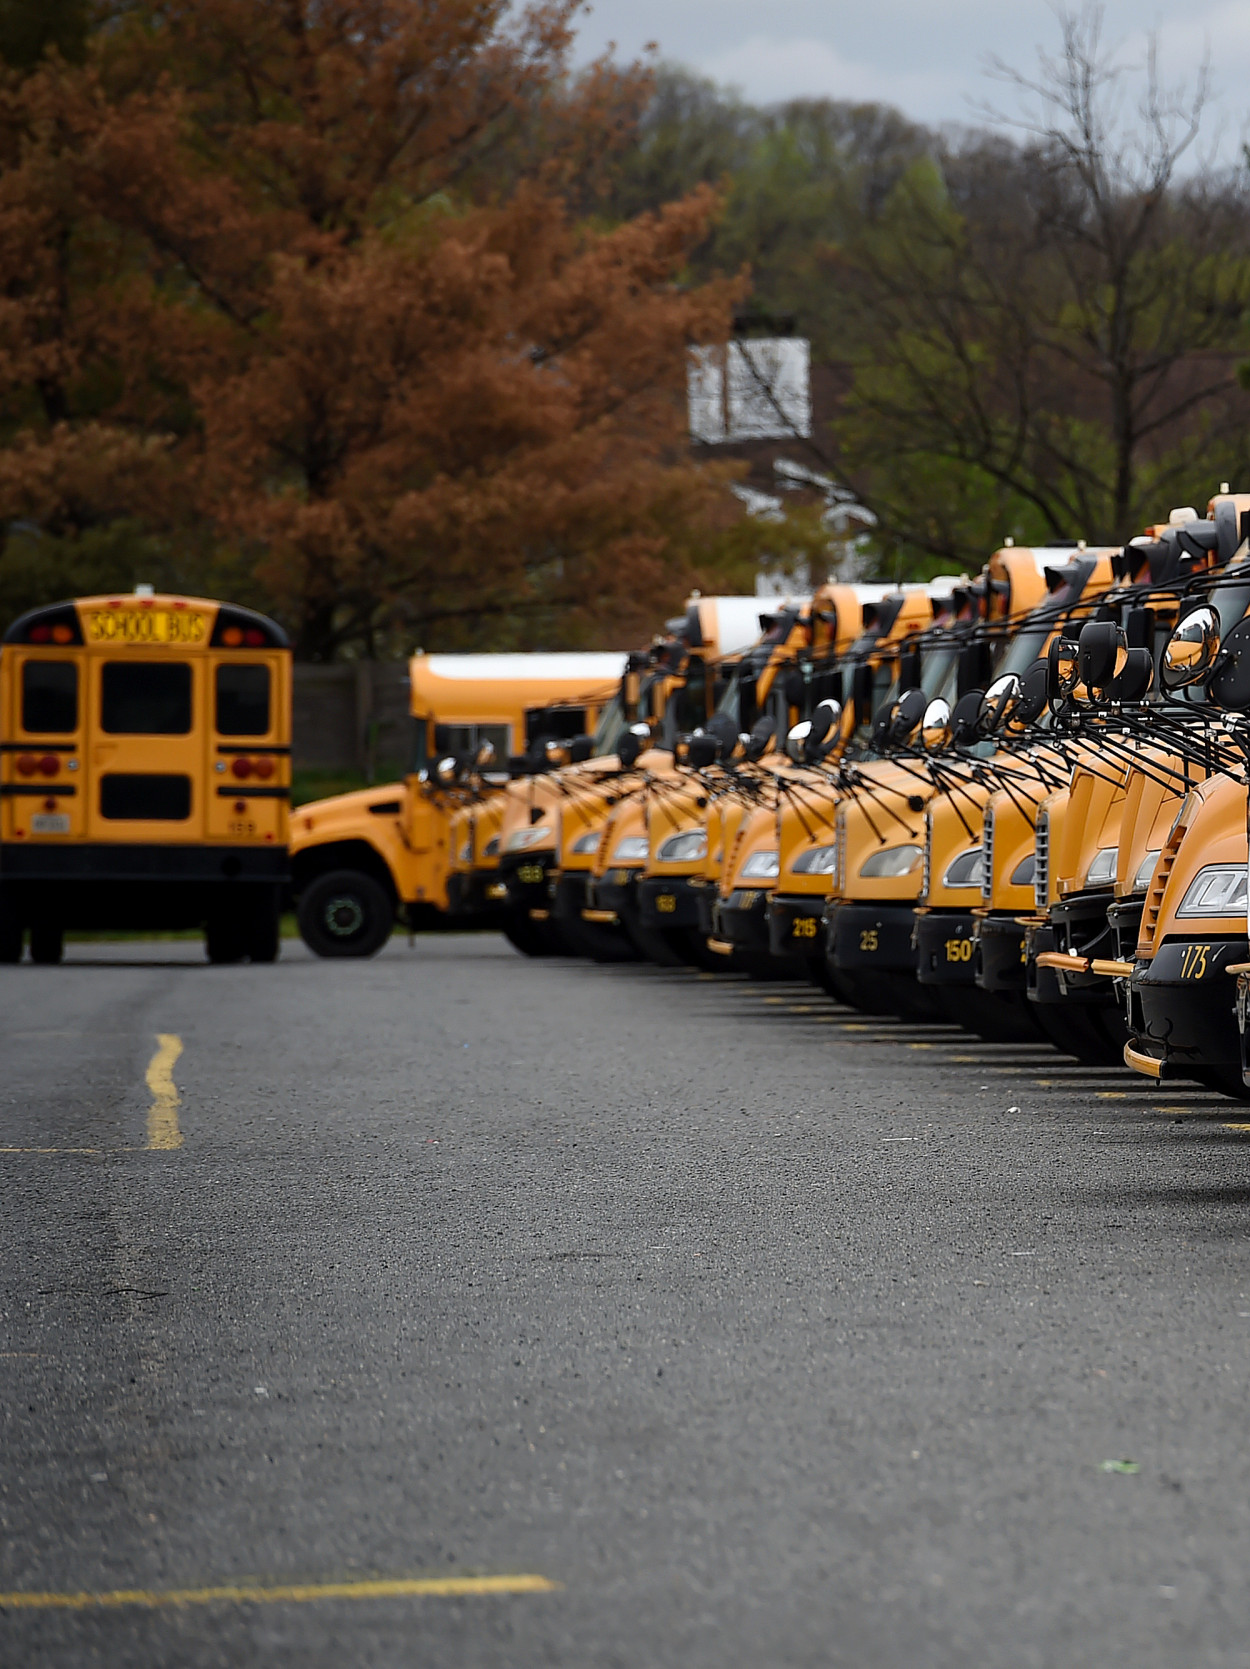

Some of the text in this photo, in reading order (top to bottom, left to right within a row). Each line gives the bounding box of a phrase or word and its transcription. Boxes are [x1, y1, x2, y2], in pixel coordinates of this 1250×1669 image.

[89, 611, 204, 641] SCHOOL BUS
[860, 930, 879, 951] 25
[944, 939, 972, 962] 150
[1181, 945, 1211, 979] 175
